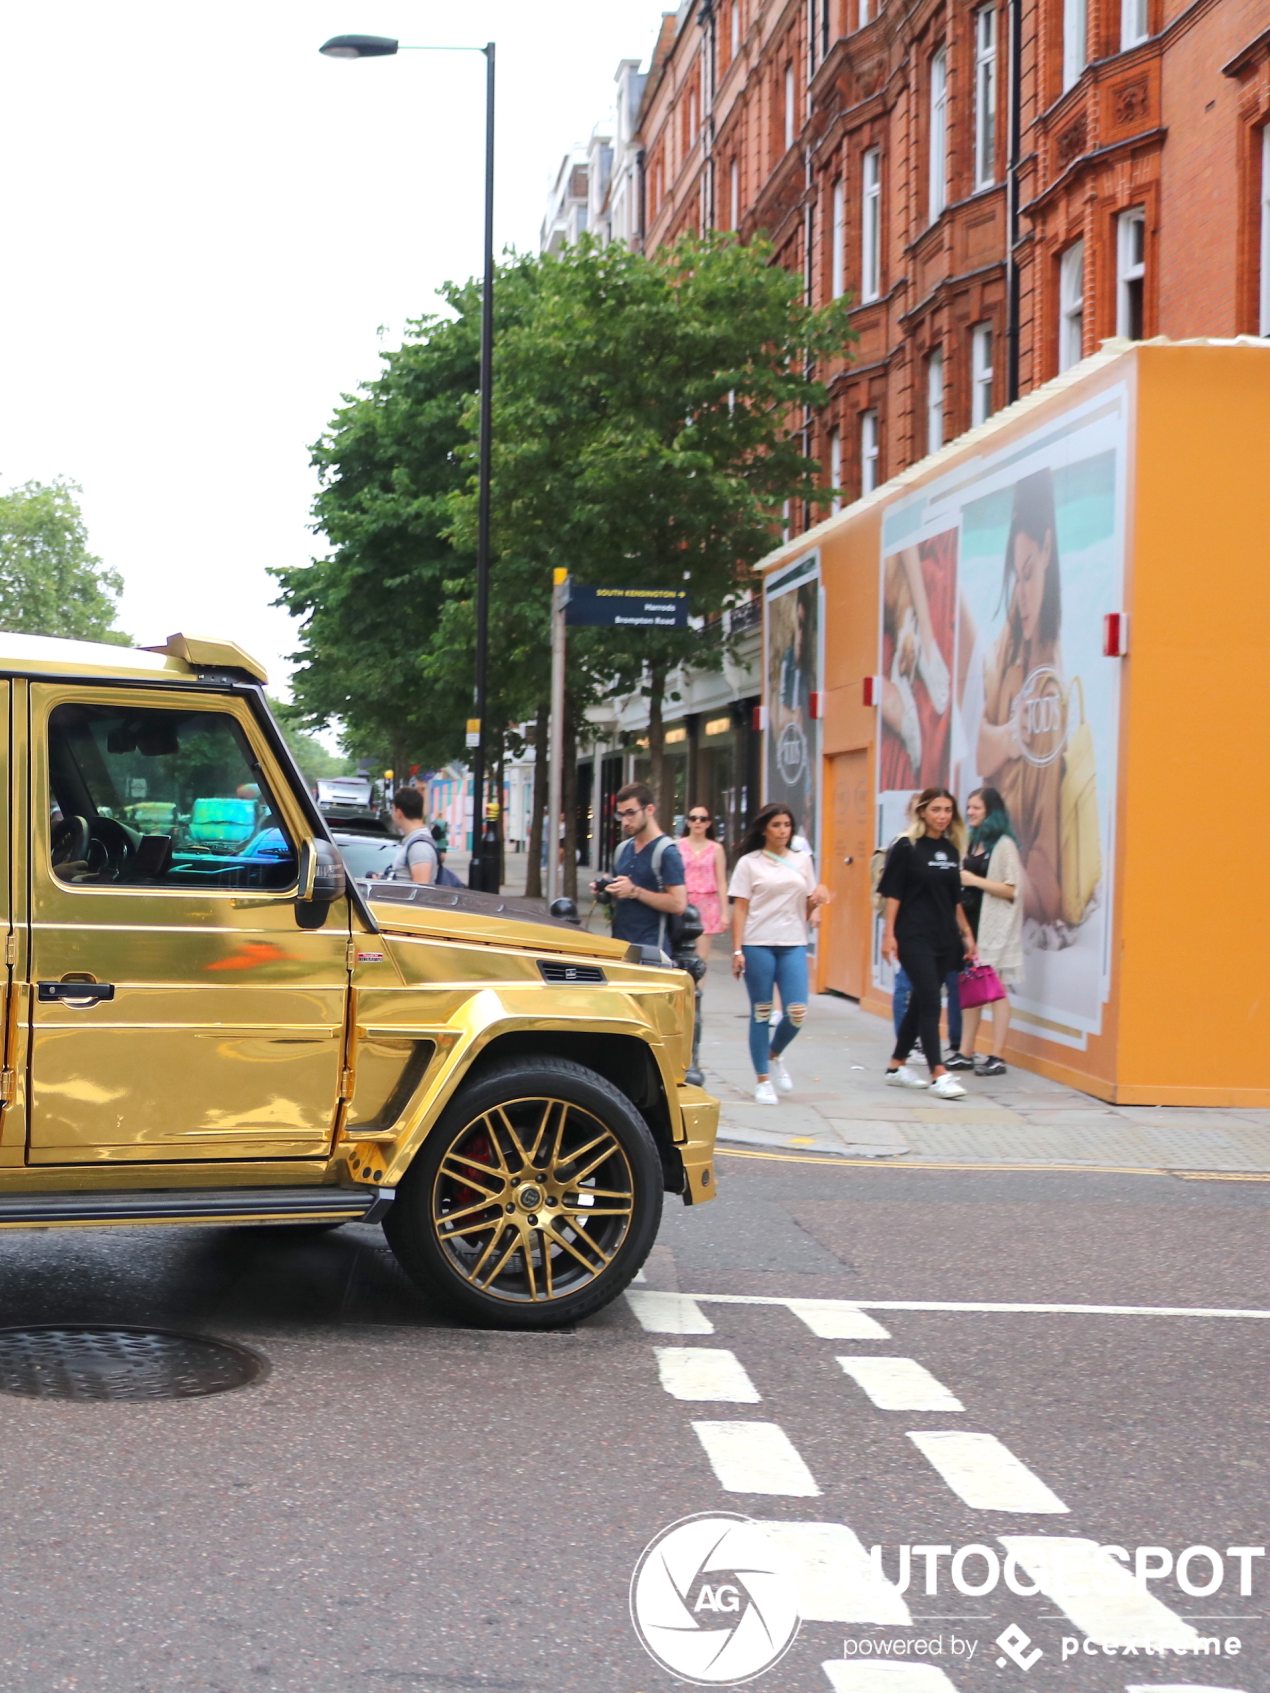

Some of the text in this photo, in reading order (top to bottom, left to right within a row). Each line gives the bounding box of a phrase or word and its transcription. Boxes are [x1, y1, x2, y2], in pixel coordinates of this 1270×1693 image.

[595, 588, 676, 598] SOUTH KENSINGTON
[644, 602, 676, 612] Harrods
[614, 614, 676, 626] Brompton Road
